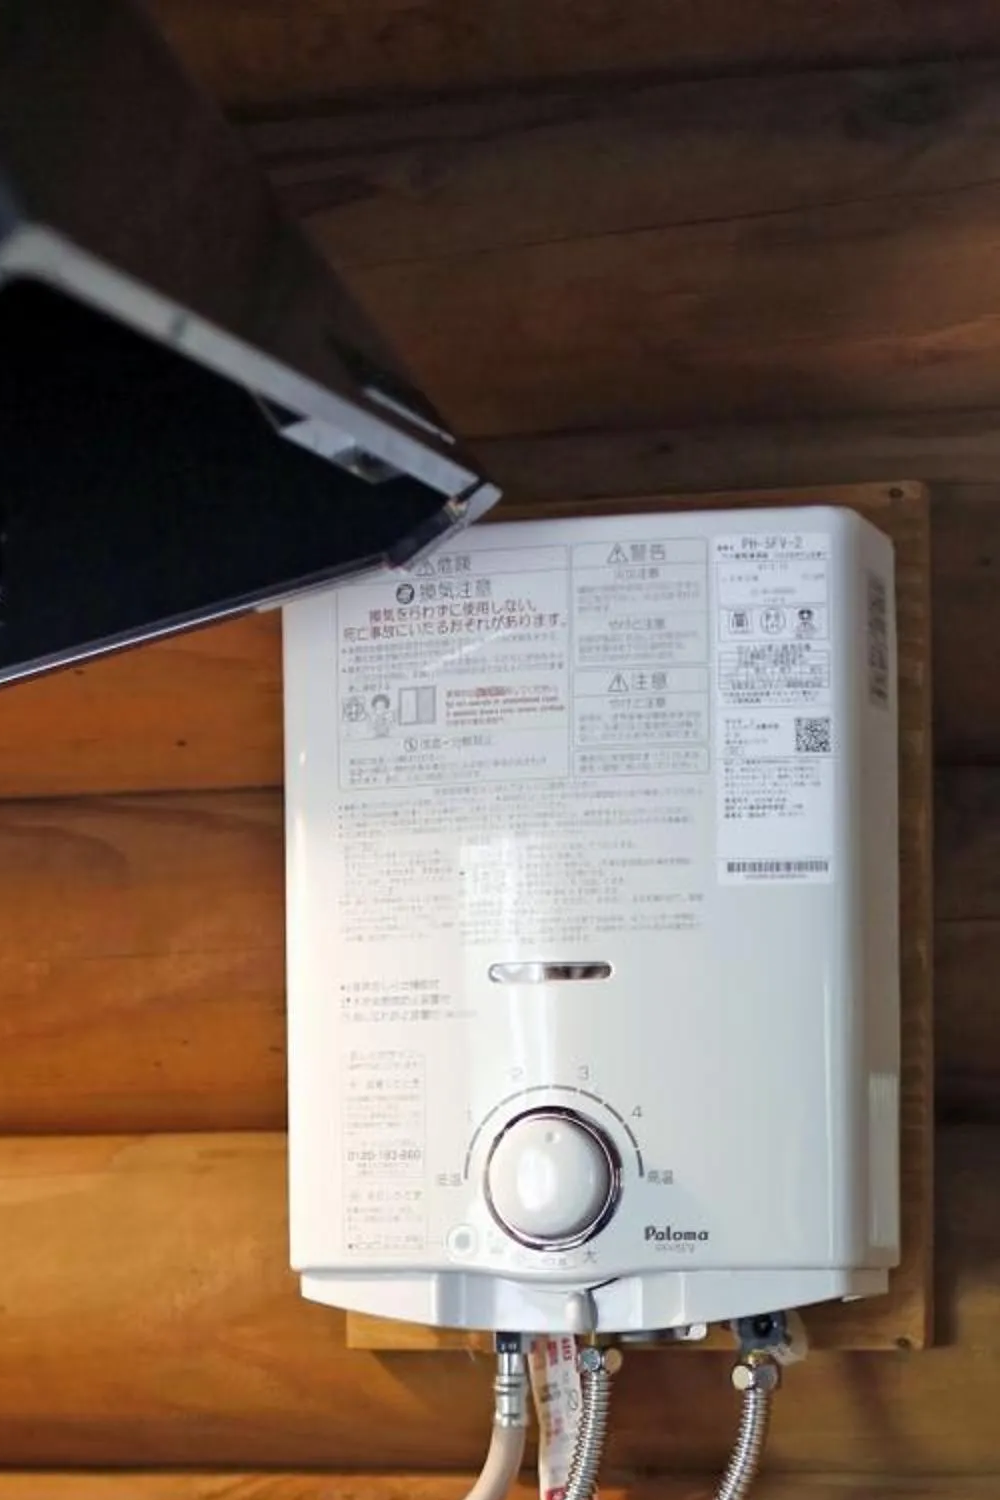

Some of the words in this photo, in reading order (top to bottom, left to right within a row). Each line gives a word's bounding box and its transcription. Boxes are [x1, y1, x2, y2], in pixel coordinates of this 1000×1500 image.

[578, 1065, 590, 1081] 3
[631, 1105, 643, 1119] 4
[644, 1224, 710, 1242] Paloma
